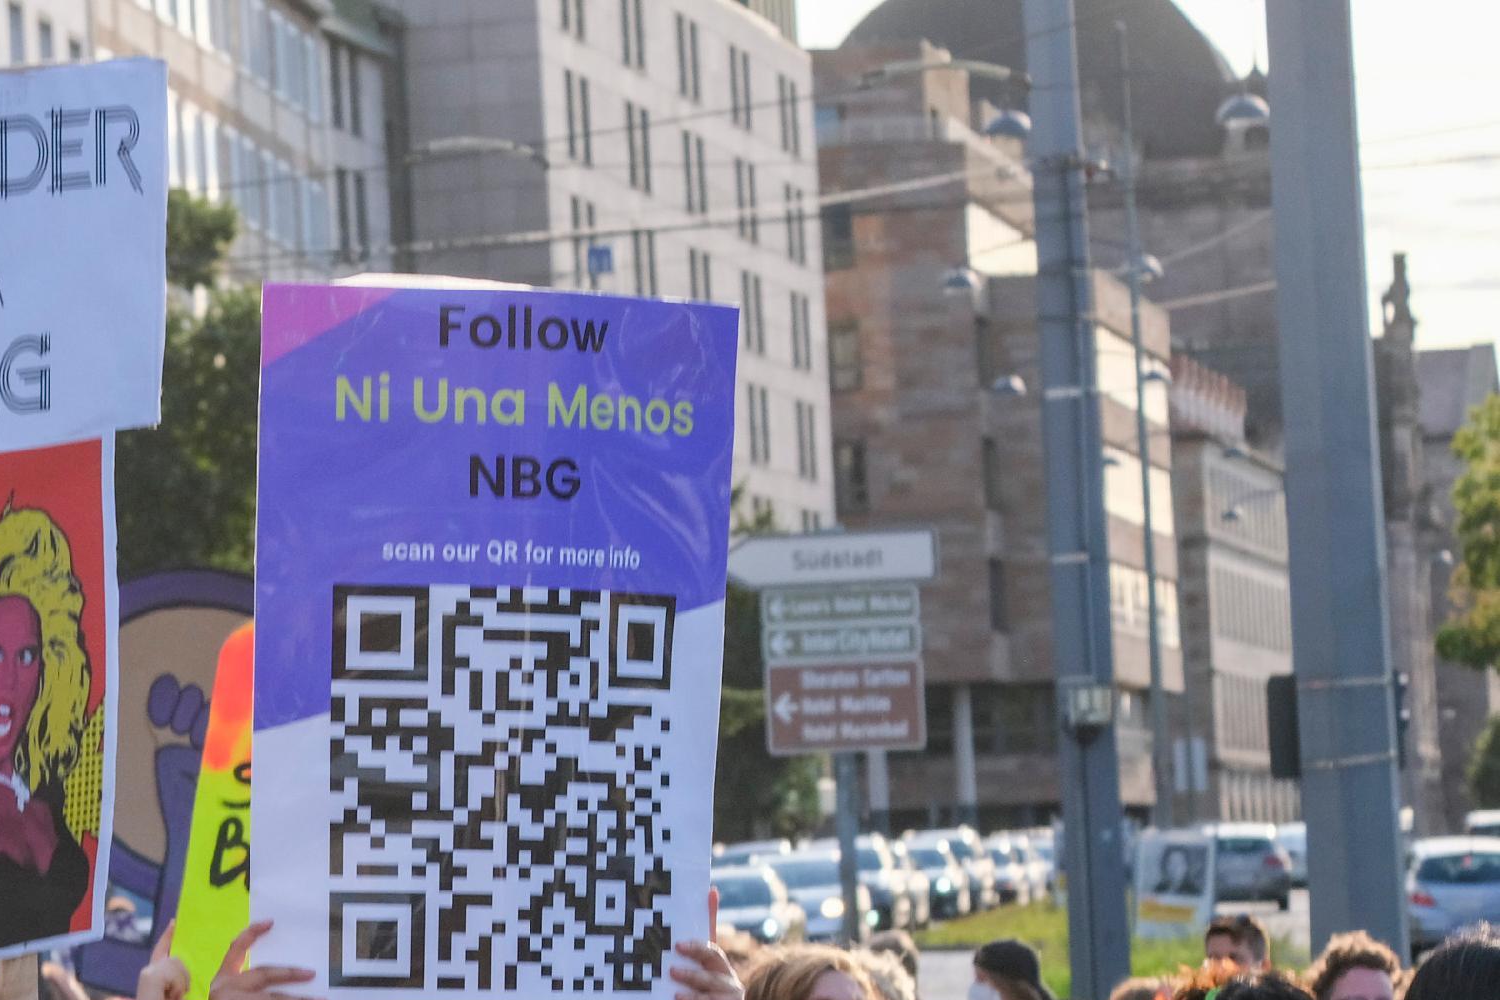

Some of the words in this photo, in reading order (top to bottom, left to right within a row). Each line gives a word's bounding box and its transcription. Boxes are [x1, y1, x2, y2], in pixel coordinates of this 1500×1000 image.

[438, 303, 609, 354] Follow
[334, 372, 391, 424] Ni
[412, 376, 526, 427] Una
[546, 381, 694, 437] Menos
[468, 453, 582, 502] NBG
[382, 540, 436, 563] scan
[441, 542, 481, 564] our
[486, 538, 519, 567] QR
[525, 538, 555, 566] for
[558, 545, 606, 568] more
[791, 549, 885, 571] Südstadt
